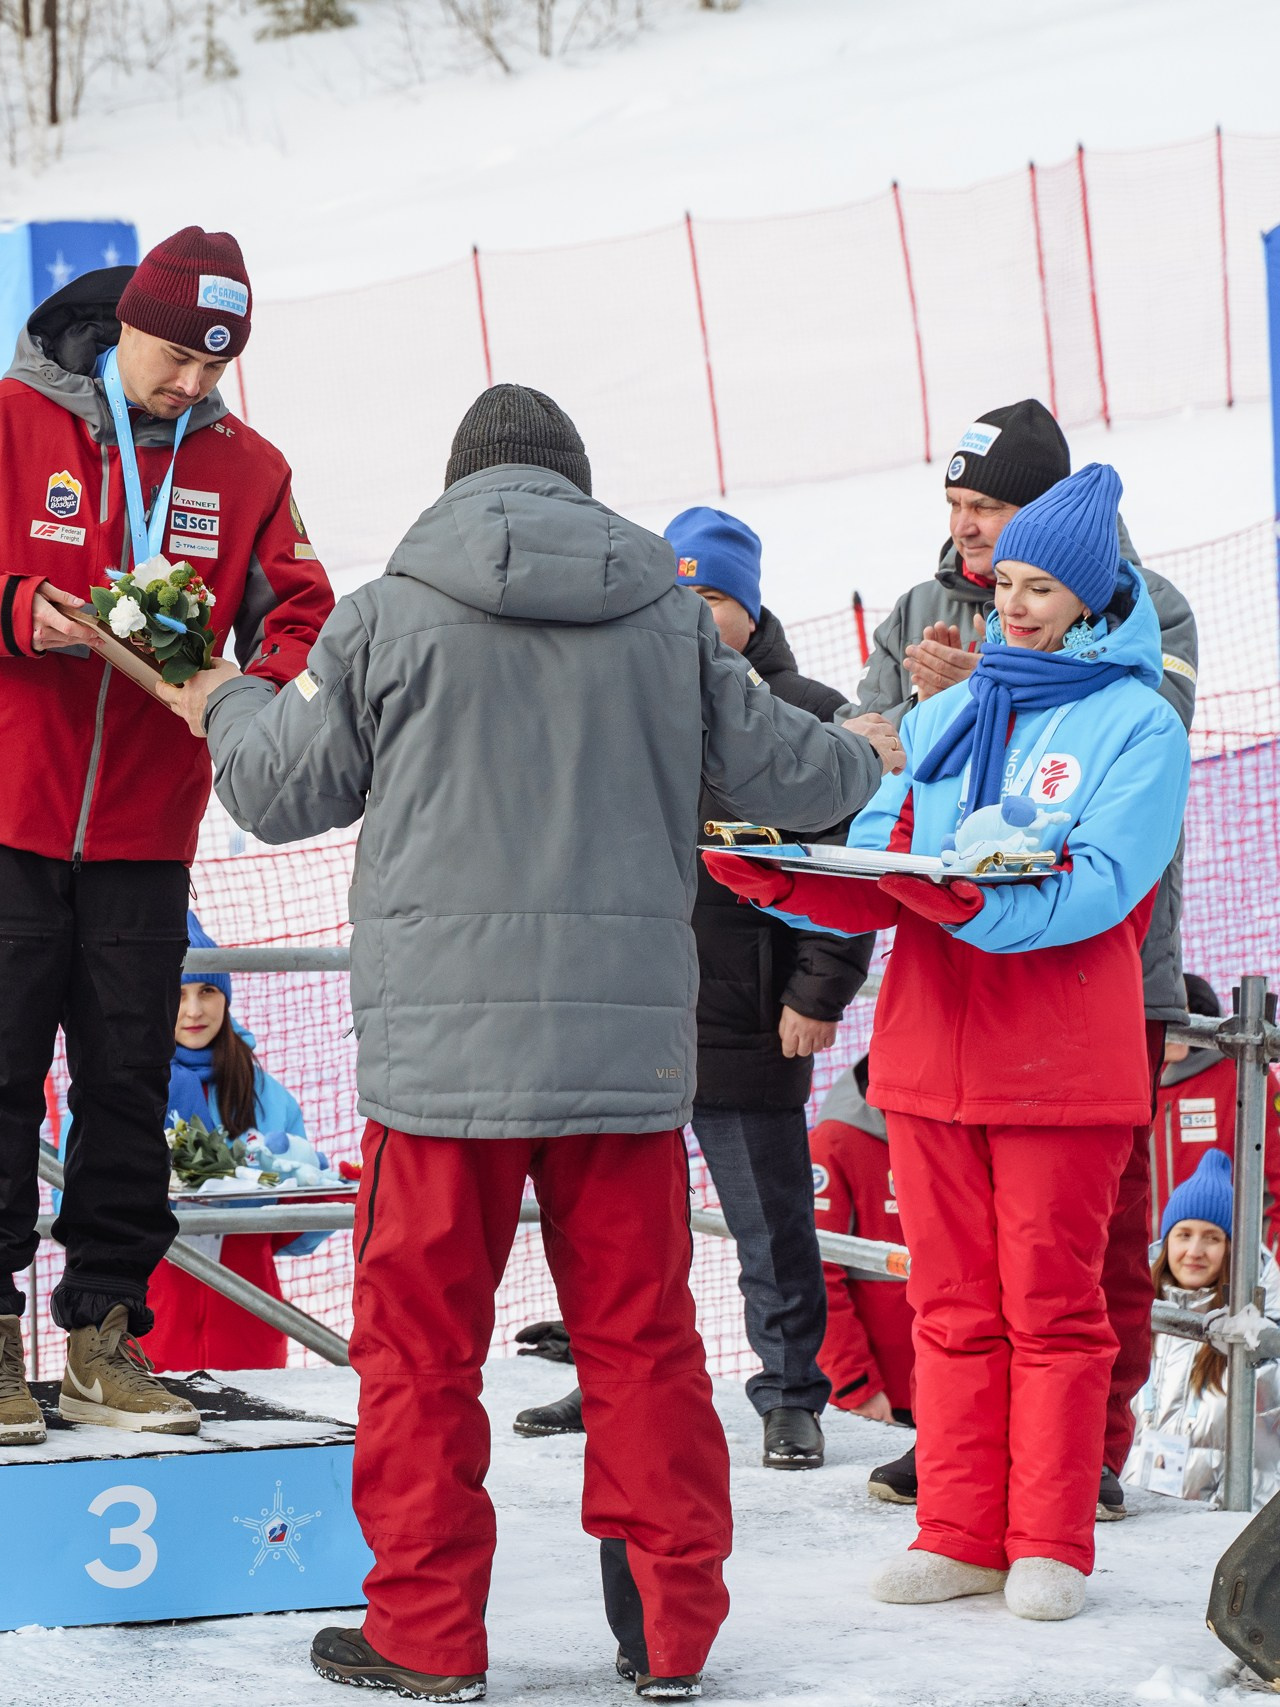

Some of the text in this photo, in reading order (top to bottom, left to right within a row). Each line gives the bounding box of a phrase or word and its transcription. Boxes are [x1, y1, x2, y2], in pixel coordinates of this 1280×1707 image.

[181, 498, 217, 509] TATNEFT
[189, 516, 217, 532] SGT
[61, 527, 82, 536] Federal
[60, 534, 80, 543] Freight
[84, 1484, 158, 1589] 3
